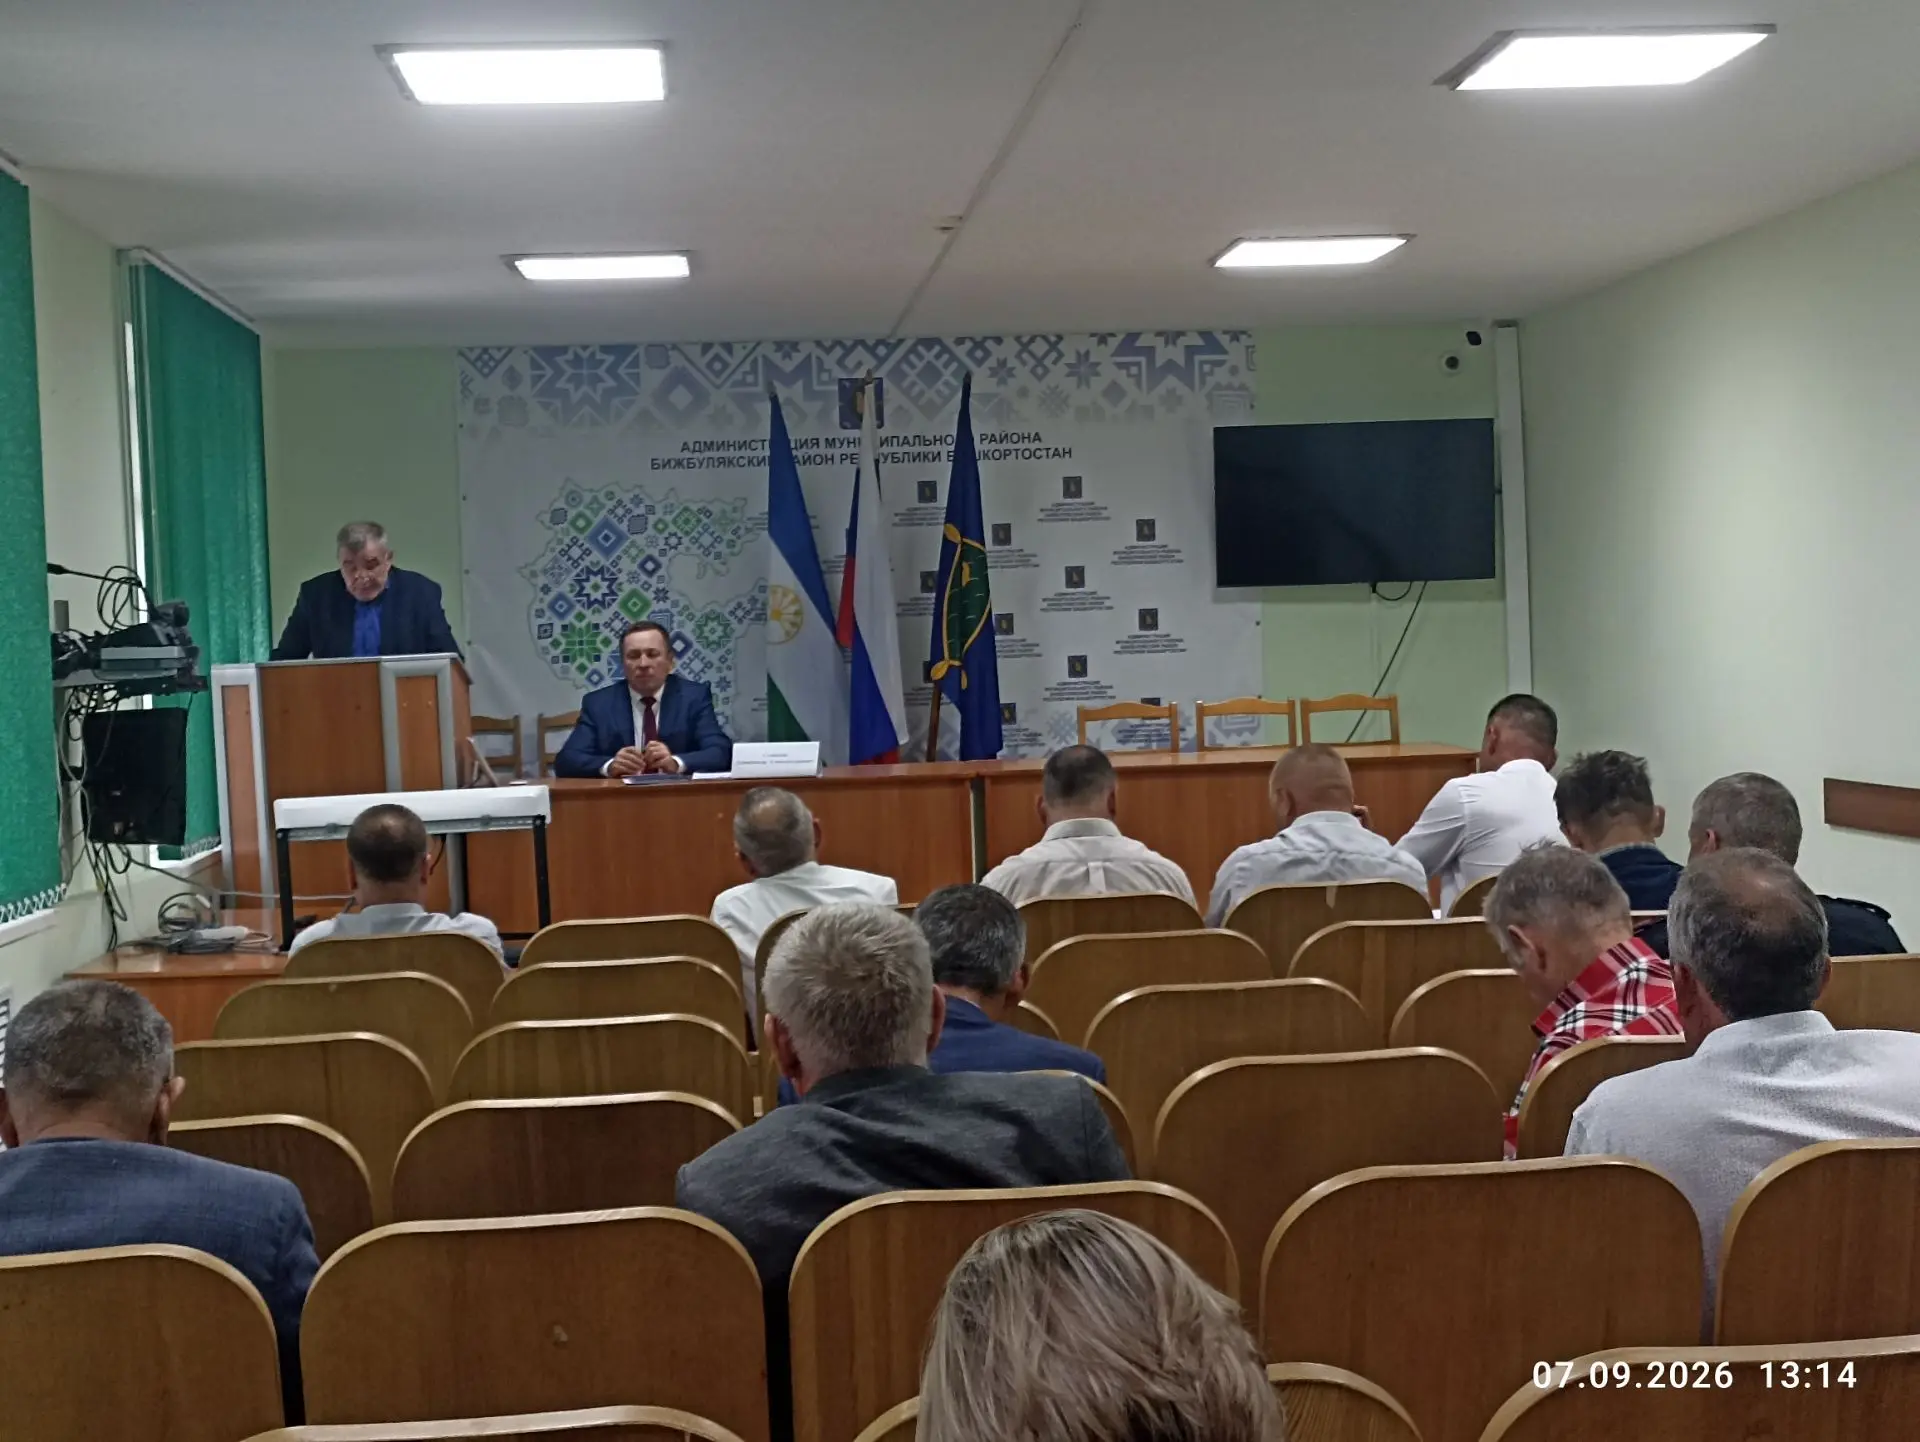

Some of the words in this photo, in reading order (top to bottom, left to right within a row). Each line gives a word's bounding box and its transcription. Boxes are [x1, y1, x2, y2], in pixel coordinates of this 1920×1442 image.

[680, 438, 820, 453] АДМИНИСТЦИЯ
[979, 431, 1042, 445] РАЙОНА
[788, 452, 835, 467] АЙОН
[840, 449, 941, 466] РЕУБЛИКИ
